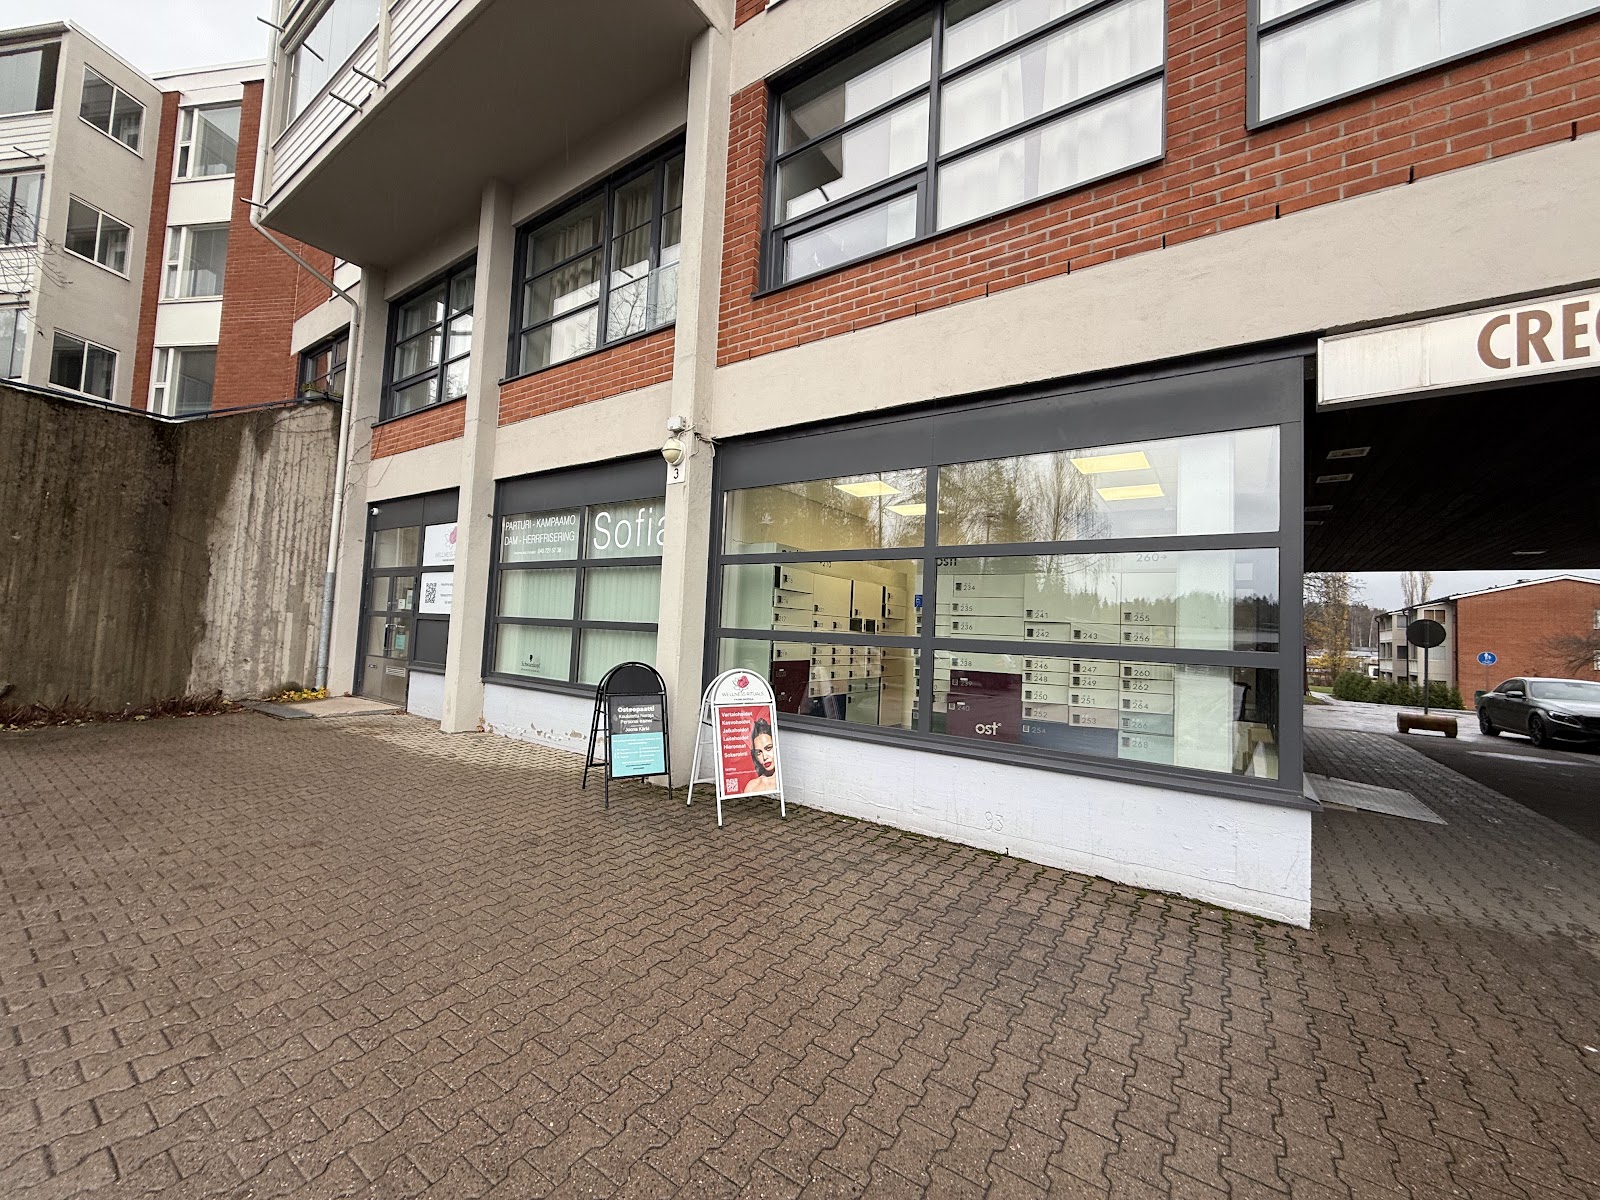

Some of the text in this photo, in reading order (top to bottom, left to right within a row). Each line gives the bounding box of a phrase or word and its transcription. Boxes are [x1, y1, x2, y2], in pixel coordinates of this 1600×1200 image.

[1477, 301, 1600, 370] CRE
[674, 468, 679, 479] 3
[505, 520, 532, 531] PARTURI
[536, 514, 576, 528] KAMPAAMO
[593, 507, 665, 550] Sofia
[504, 536, 518, 546] DAM
[522, 531, 575, 544] HERRFRISERING
[618, 705, 655, 713] Osteopaatti
[1132, 740, 1148, 748] 268
